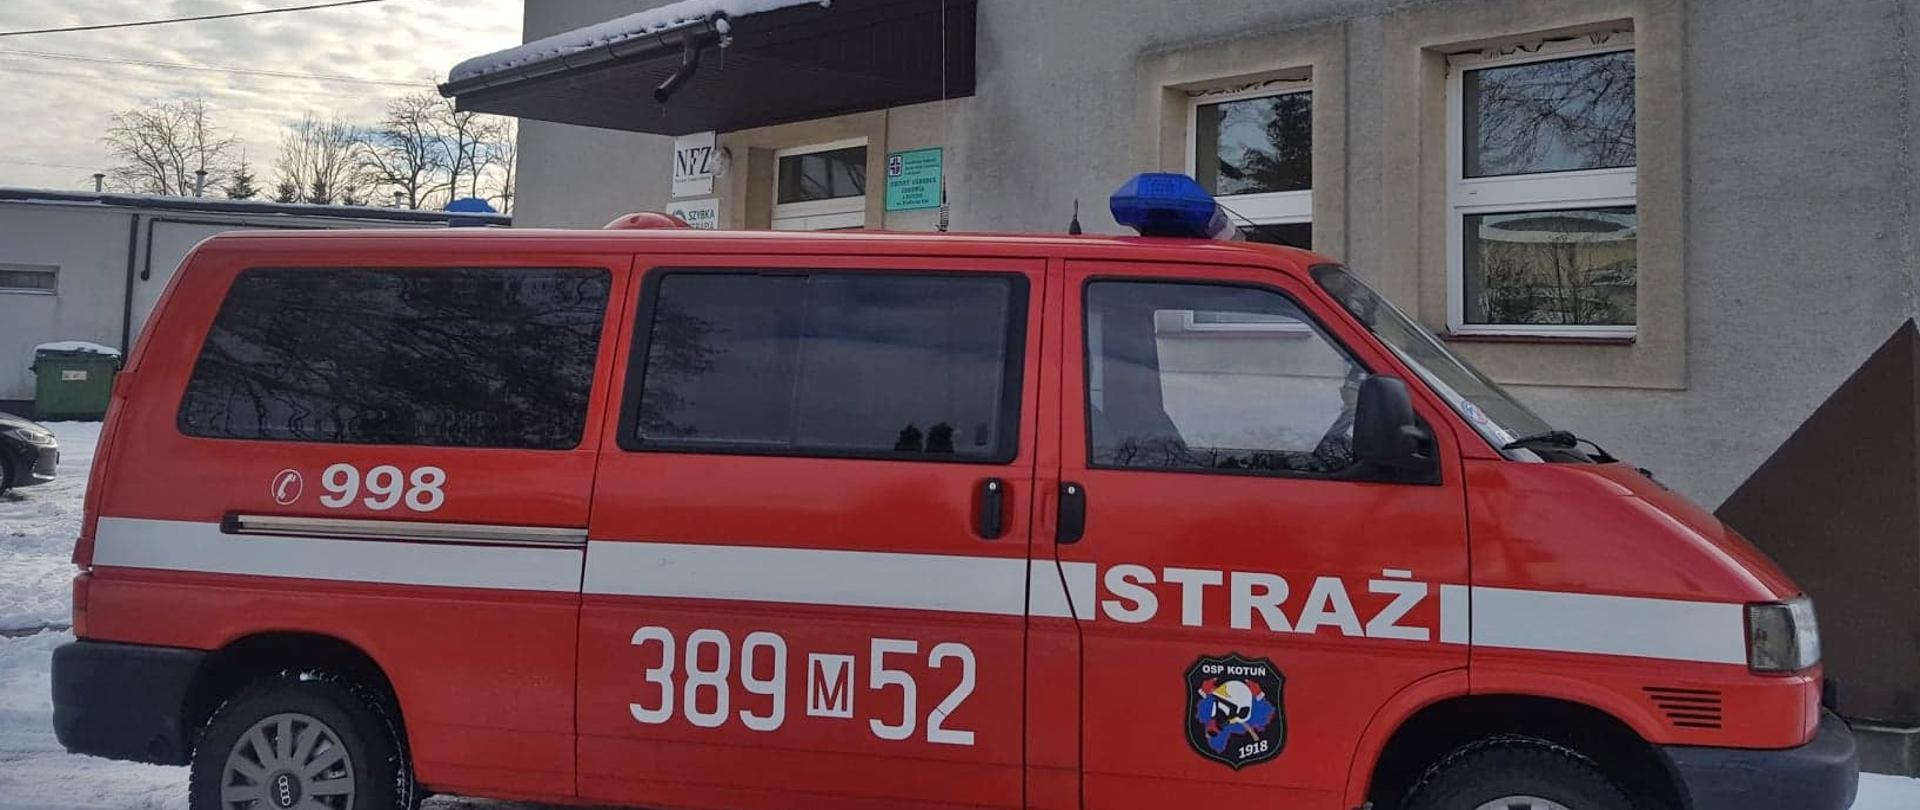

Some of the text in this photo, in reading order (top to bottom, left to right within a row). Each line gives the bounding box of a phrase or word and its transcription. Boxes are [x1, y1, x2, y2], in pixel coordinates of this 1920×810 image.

[676, 147, 713, 177] NFZ
[688, 209, 715, 221] SZYBKA
[320, 464, 446, 512] 998
[1102, 568, 1430, 641] STRAŻ
[1202, 665, 1266, 676] OSP KOTUŃ
[629, 626, 976, 746] 389 M 52
[1238, 740, 1269, 759] 1918
